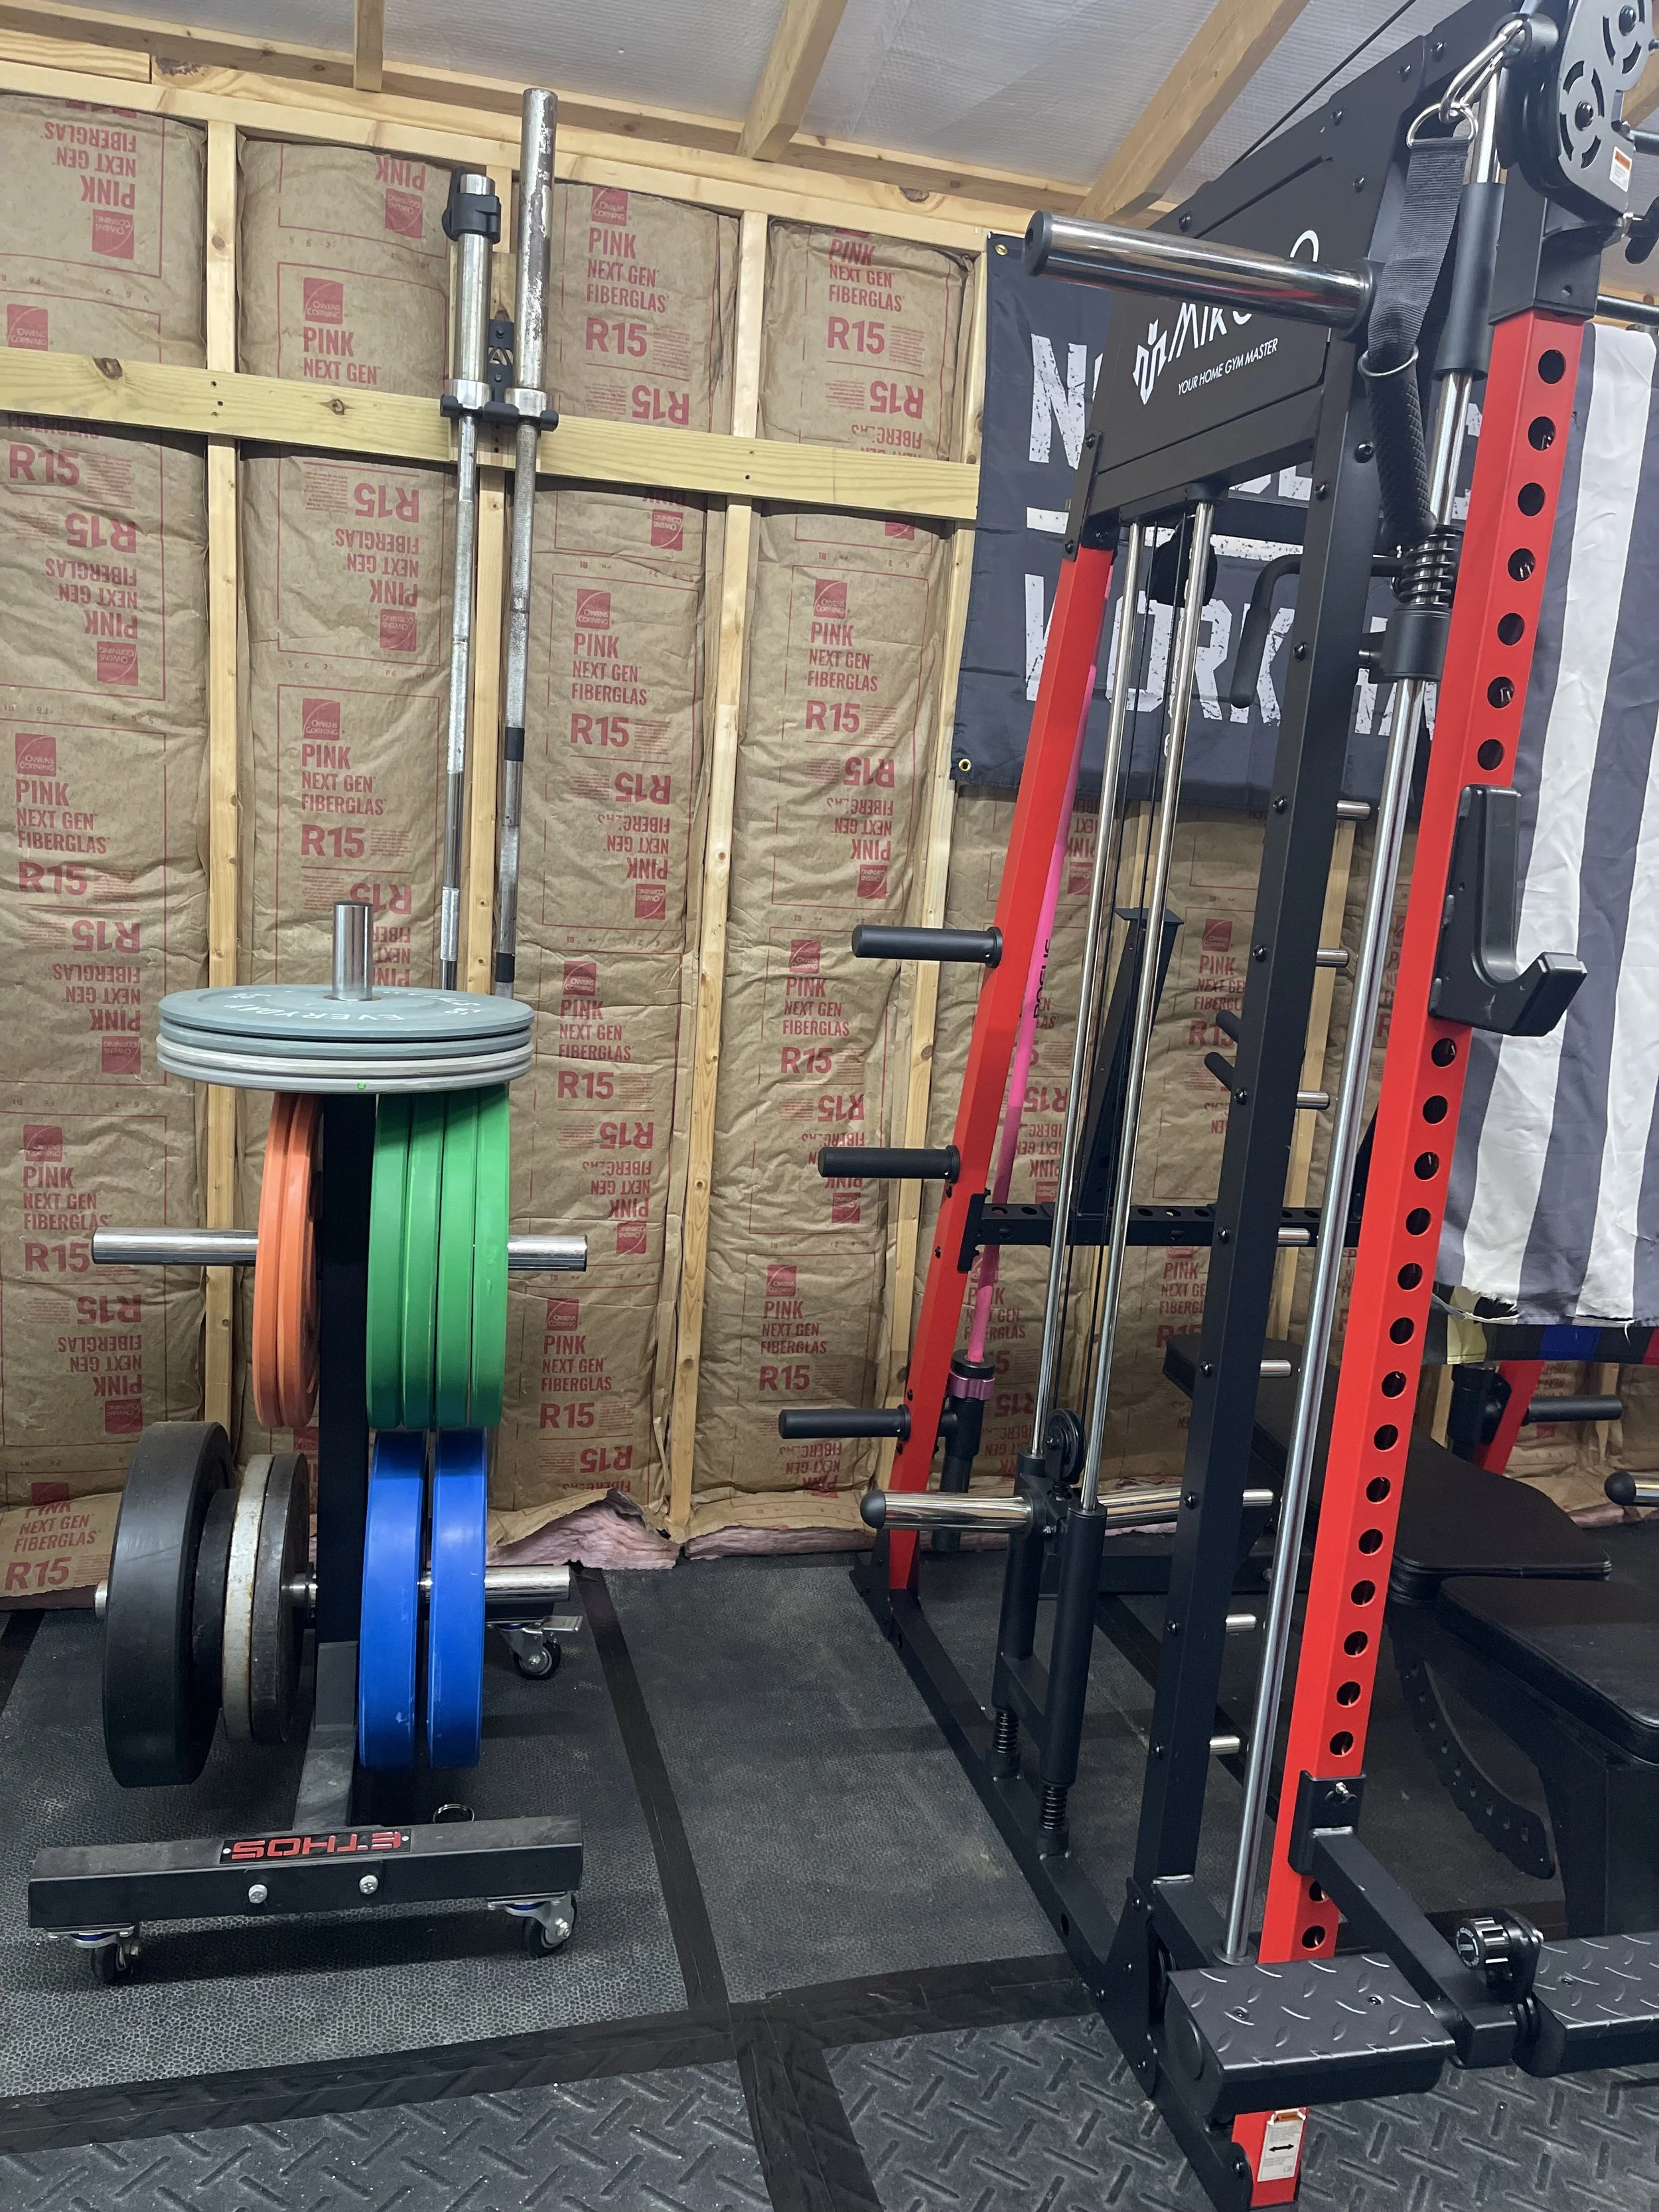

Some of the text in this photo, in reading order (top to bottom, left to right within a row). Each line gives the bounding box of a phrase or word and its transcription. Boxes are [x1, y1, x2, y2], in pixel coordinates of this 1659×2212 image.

[44, 121, 137, 153] FIBERGLAS
[56, 147, 136, 178] NEXT GEN
[376, 155, 425, 190] PINK
[81, 175, 135, 209] PINK
[589, 227, 636, 259] PINK
[830, 238, 875, 266] PINK
[587, 259, 656, 288] NEXT GEN
[830, 264, 892, 289] NEXT GEN
[587, 284, 666, 313] FIBERGLAS
[830, 284, 902, 313] FIBERGLAS
[303, 327, 354, 356] PINK
[585, 318, 647, 357] R15
[827, 316, 885, 354] R15
[304, 358, 376, 385] NEXT GEN
[1178, 338, 1278, 395] YOUR HOME GYM MASTER
[632, 384, 689, 425] R15
[870, 380, 924, 419] R15
[9, 444, 80, 486] R15
[354, 482, 419, 523] R15
[66, 513, 137, 553] R15
[335, 529, 419, 555] FIBERGLAS
[45, 558, 137, 587] FIBERGLAS
[347, 553, 419, 578] NEXT GEN
[58, 583, 137, 609] NEXT GEN
[370, 579, 418, 607] PINK
[84, 610, 137, 639] PINK
[811, 621, 854, 646] PINK
[573, 633, 619, 658] PINK
[573, 660, 638, 683] NEXT GEN
[810, 648, 870, 670] NEXT GEN
[572, 682, 647, 705] FIBERGLAS
[808, 670, 878, 692] FIBERGLAS
[805, 700, 860, 733] R15
[571, 713, 629, 747] R15
[302, 743, 351, 769] PINK
[302, 771, 373, 793] NEXT GEN
[843, 757, 895, 788] R15
[16, 778, 69, 806] PINK
[614, 773, 671, 805] R15
[301, 794, 384, 816] FIBERGLAS
[17, 808, 94, 830] NEXT GEN
[835, 818, 892, 836] NEXT GEN
[18, 834, 106, 854] FIBERGLAS
[301, 824, 364, 859] R15
[607, 835, 669, 855] NEXT GEN
[850, 839, 891, 861] PINK
[19, 861, 87, 895] R15
[626, 858, 668, 879] PINK
[72, 920, 141, 954] R15
[53, 964, 141, 984] FIBERGLAS
[1199, 955, 1236, 975] PINK
[66, 986, 141, 1005] NEXT GEN
[786, 976, 826, 997] PINK
[1196, 978, 1224, 992] NEXT
[89, 1009, 141, 1031] PINK
[561, 999, 604, 1020] PINK
[785, 1001, 842, 1017] NEXT GEN
[560, 1023, 622, 1041] NEXT GEN
[782, 1020, 849, 1037] FIBERGLAS
[559, 1045, 630, 1061] FIBERGLAS
[780, 1047, 832, 1074] R15
[557, 1071, 614, 1100] R15
[818, 1094, 863, 1122] R15
[599, 1122, 654, 1149] R15
[22, 1167, 74, 1188] PINK
[591, 1181, 650, 1194] NEXT GEN
[23, 1193, 96, 1209] NEXT GEN
[609, 1199, 648, 1217] PINK
[24, 1213, 108, 1229] FIBERGLAS
[25, 1242, 90, 1272] R15
[1163, 1262, 1198, 1279] PINK
[1160, 1284, 1188, 1296] NEXT
[76, 1295, 141, 1325] R15
[764, 1301, 803, 1319] PINK
[763, 1323, 820, 1336] NEXT GEN
[58, 1335, 141, 1353] FIBERGLAS
[543, 1335, 586, 1355] PINK
[761, 1341, 828, 1355] FIBERGLAS
[70, 1356, 141, 1373] NEXT GEN
[542, 1359, 604, 1373] NEXT GEN
[759, 1364, 810, 1390] R15
[94, 1376, 143, 1396] PINK
[541, 1376, 611, 1392] FIBERGLAS
[540, 1402, 595, 1428] R15
[580, 1445, 633, 1473] R15
[786, 1462, 840, 1475] NEXT GEN
[20, 1514, 89, 1534] NEXT GEN
[15, 1531, 96, 1552] FIBERGLAS
[5, 1558, 70, 1590] R15
[232, 1830, 401, 1859] ETHOS
